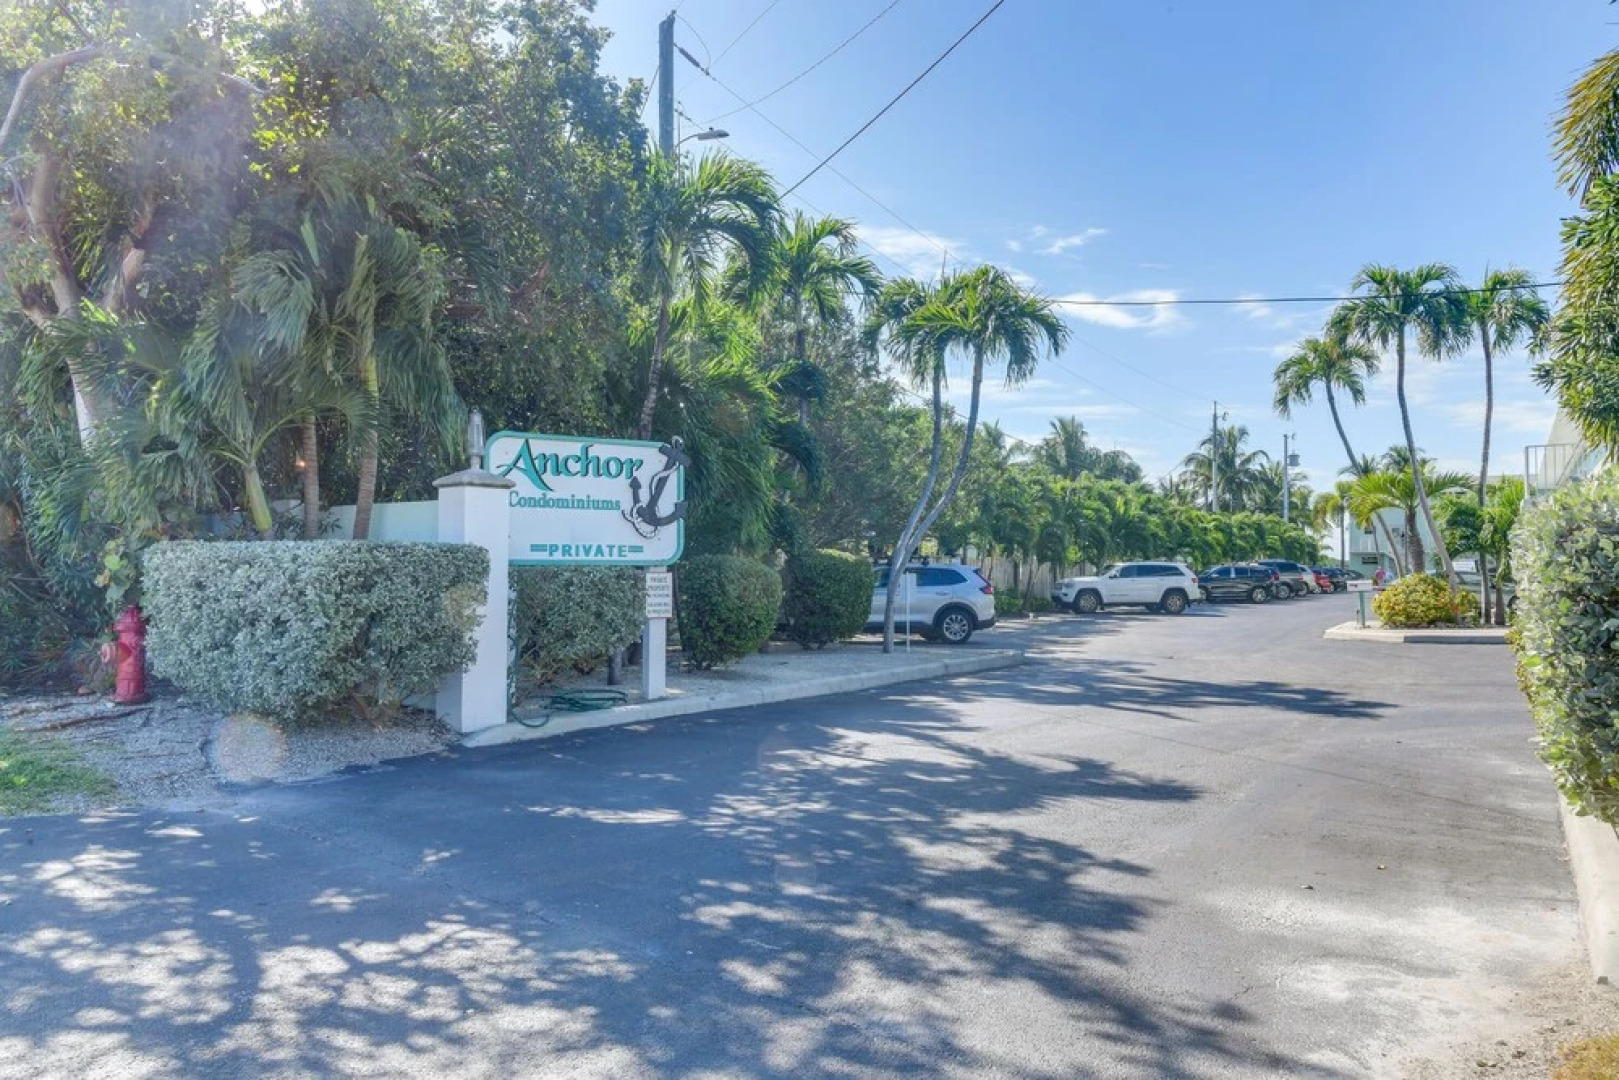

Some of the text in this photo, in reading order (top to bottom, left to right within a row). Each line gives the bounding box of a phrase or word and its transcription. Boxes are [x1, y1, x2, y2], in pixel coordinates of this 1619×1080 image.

[496, 438, 643, 492] Anchor
[509, 490, 621, 510] Condominiums
[548, 543, 628, 558] PRIVATE
